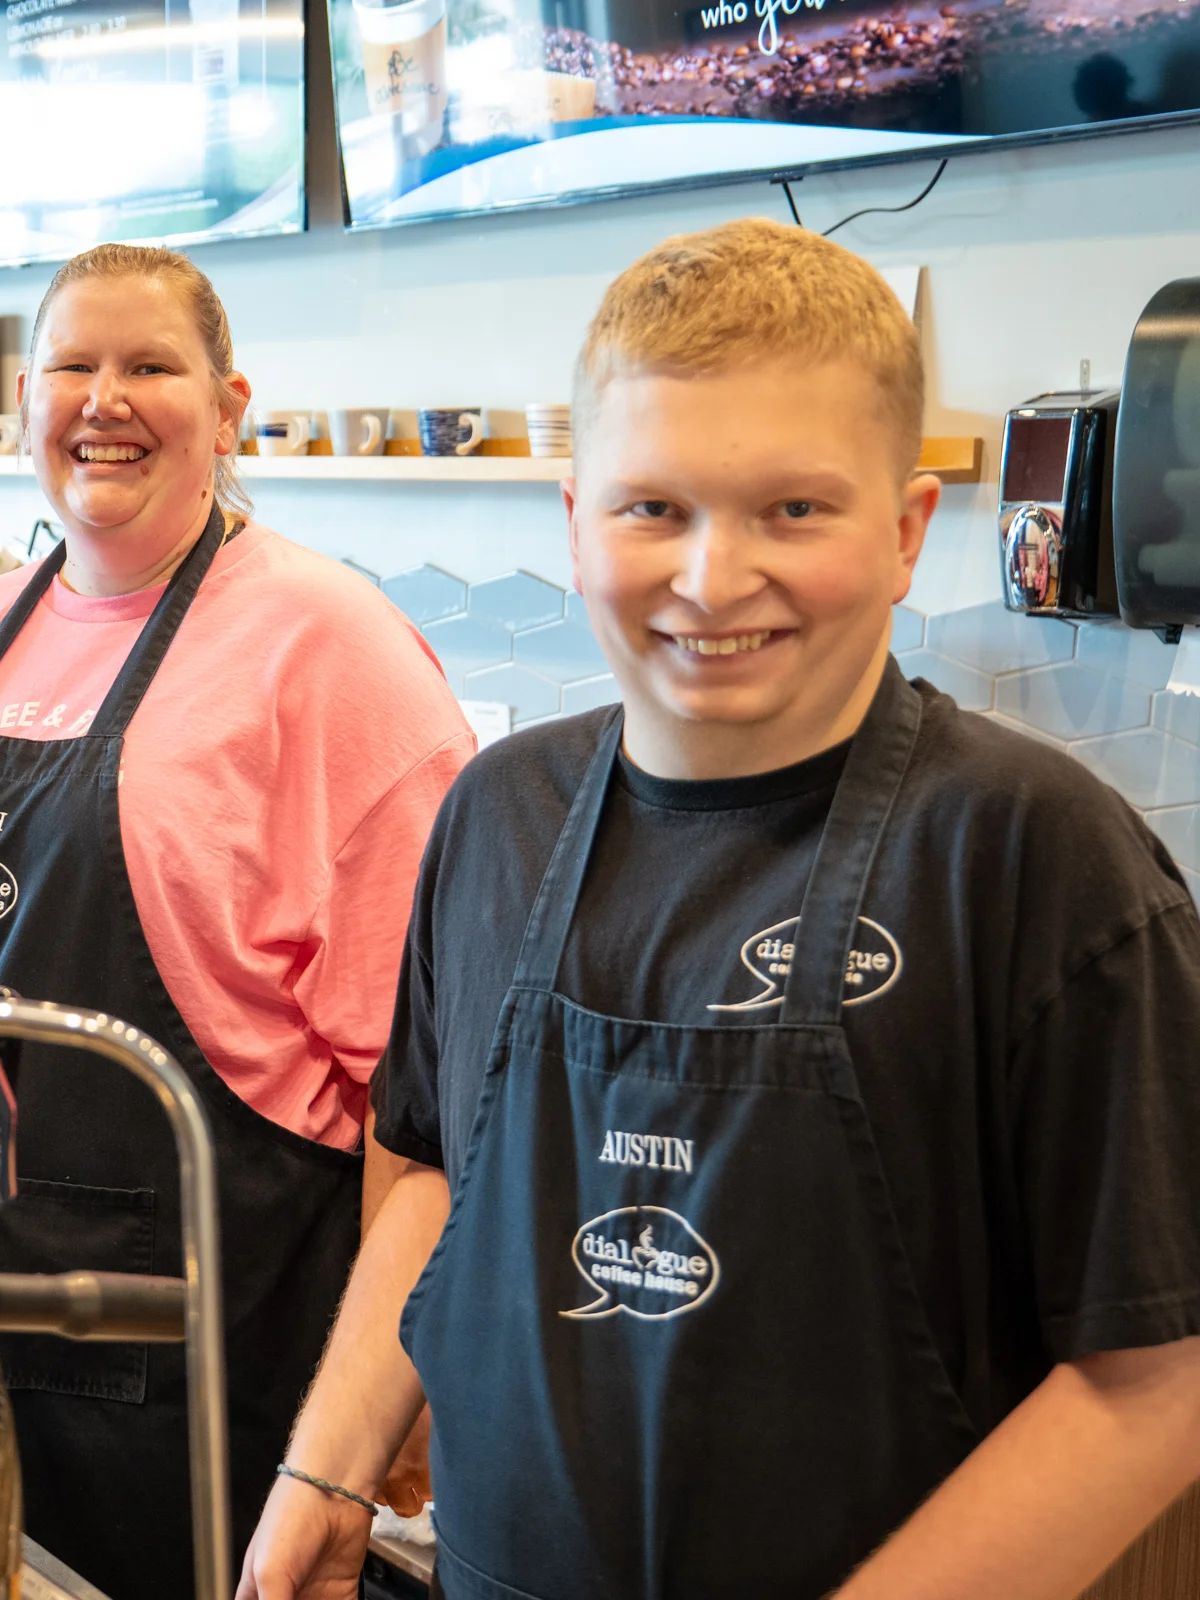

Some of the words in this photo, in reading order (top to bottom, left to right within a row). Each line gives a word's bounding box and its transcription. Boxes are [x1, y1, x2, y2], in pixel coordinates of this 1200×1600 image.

[701, 0, 748, 29] who
[42, 703, 67, 728] &
[598, 1129, 694, 1174] AUSTIN
[583, 1230, 708, 1277] dialogue
[591, 1262, 643, 1285] coffee
[644, 1272, 699, 1297] house
